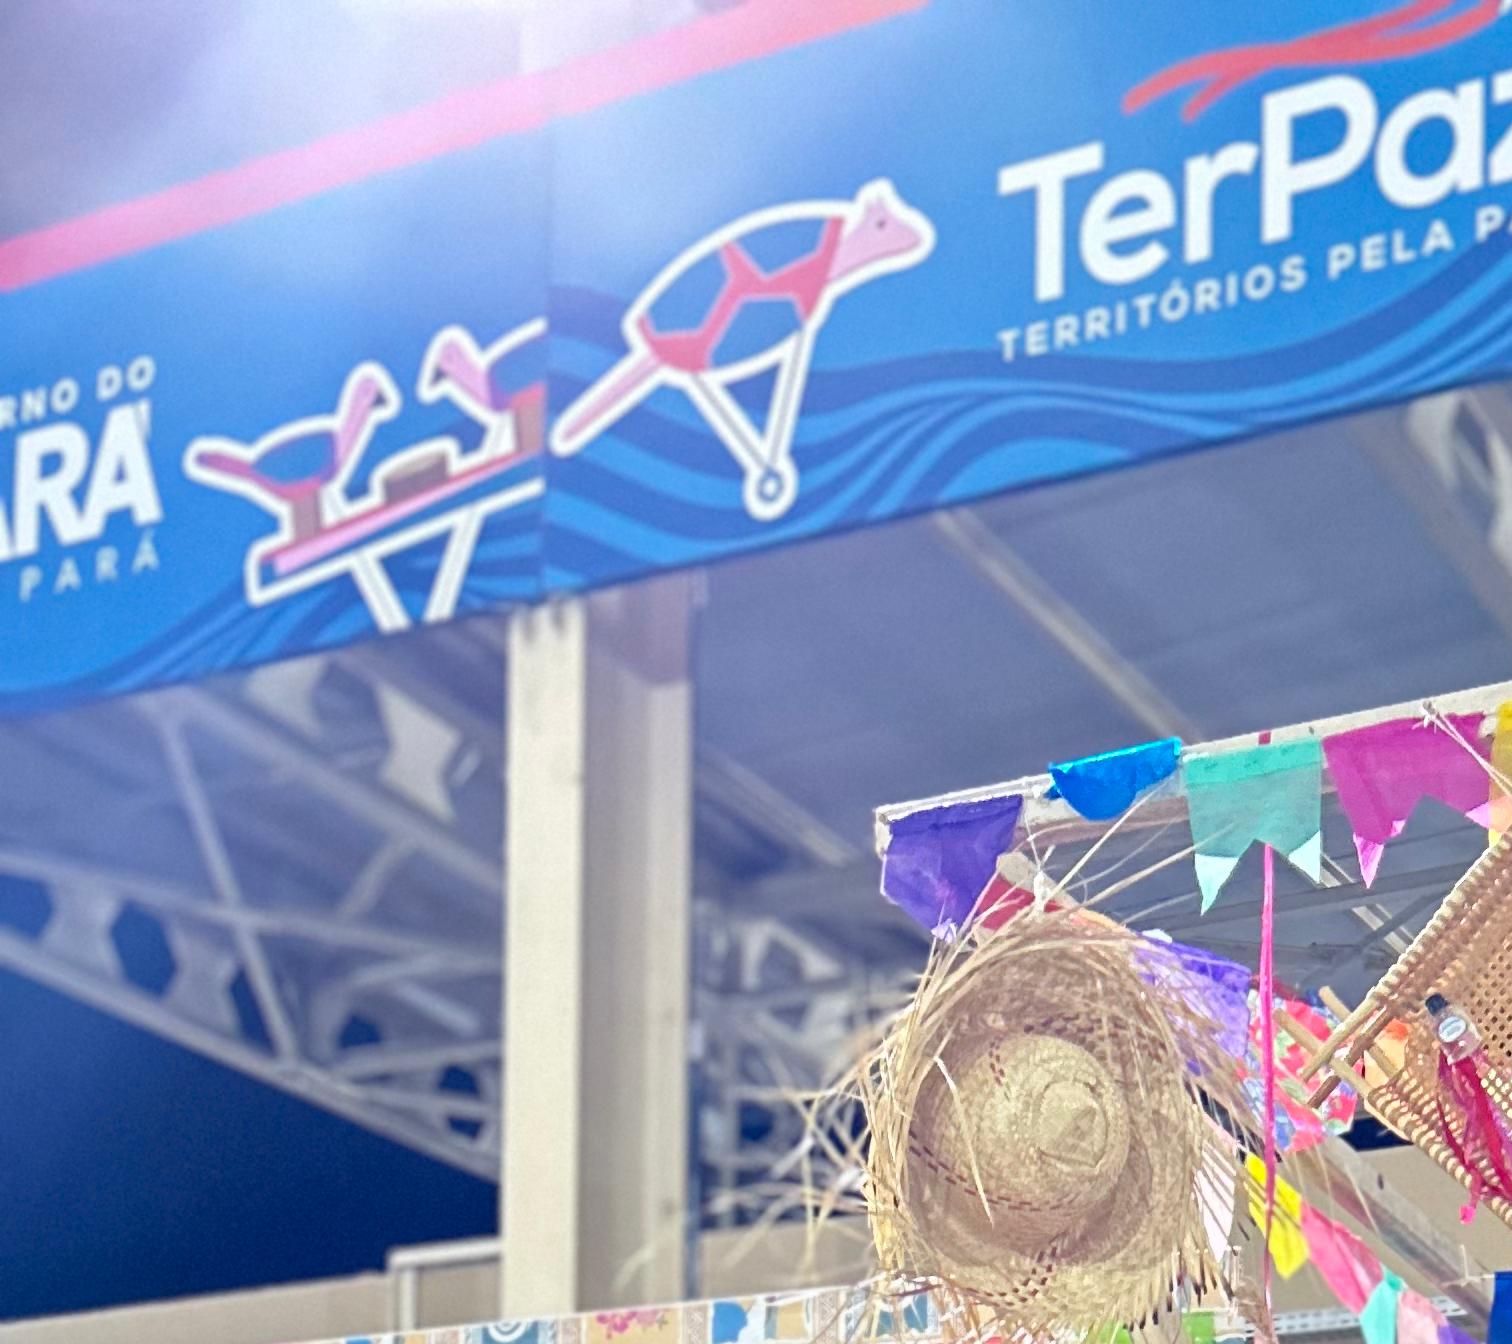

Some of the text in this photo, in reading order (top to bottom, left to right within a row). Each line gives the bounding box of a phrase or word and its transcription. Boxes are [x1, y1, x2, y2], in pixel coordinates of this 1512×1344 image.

[997, 256, 1307, 362] TERRITÓRIOS
[1328, 219, 1454, 281] PELA
[0, 355, 157, 430] RNO DO
[0, 397, 164, 562] RÁ
[19, 527, 161, 603] PARÁ
